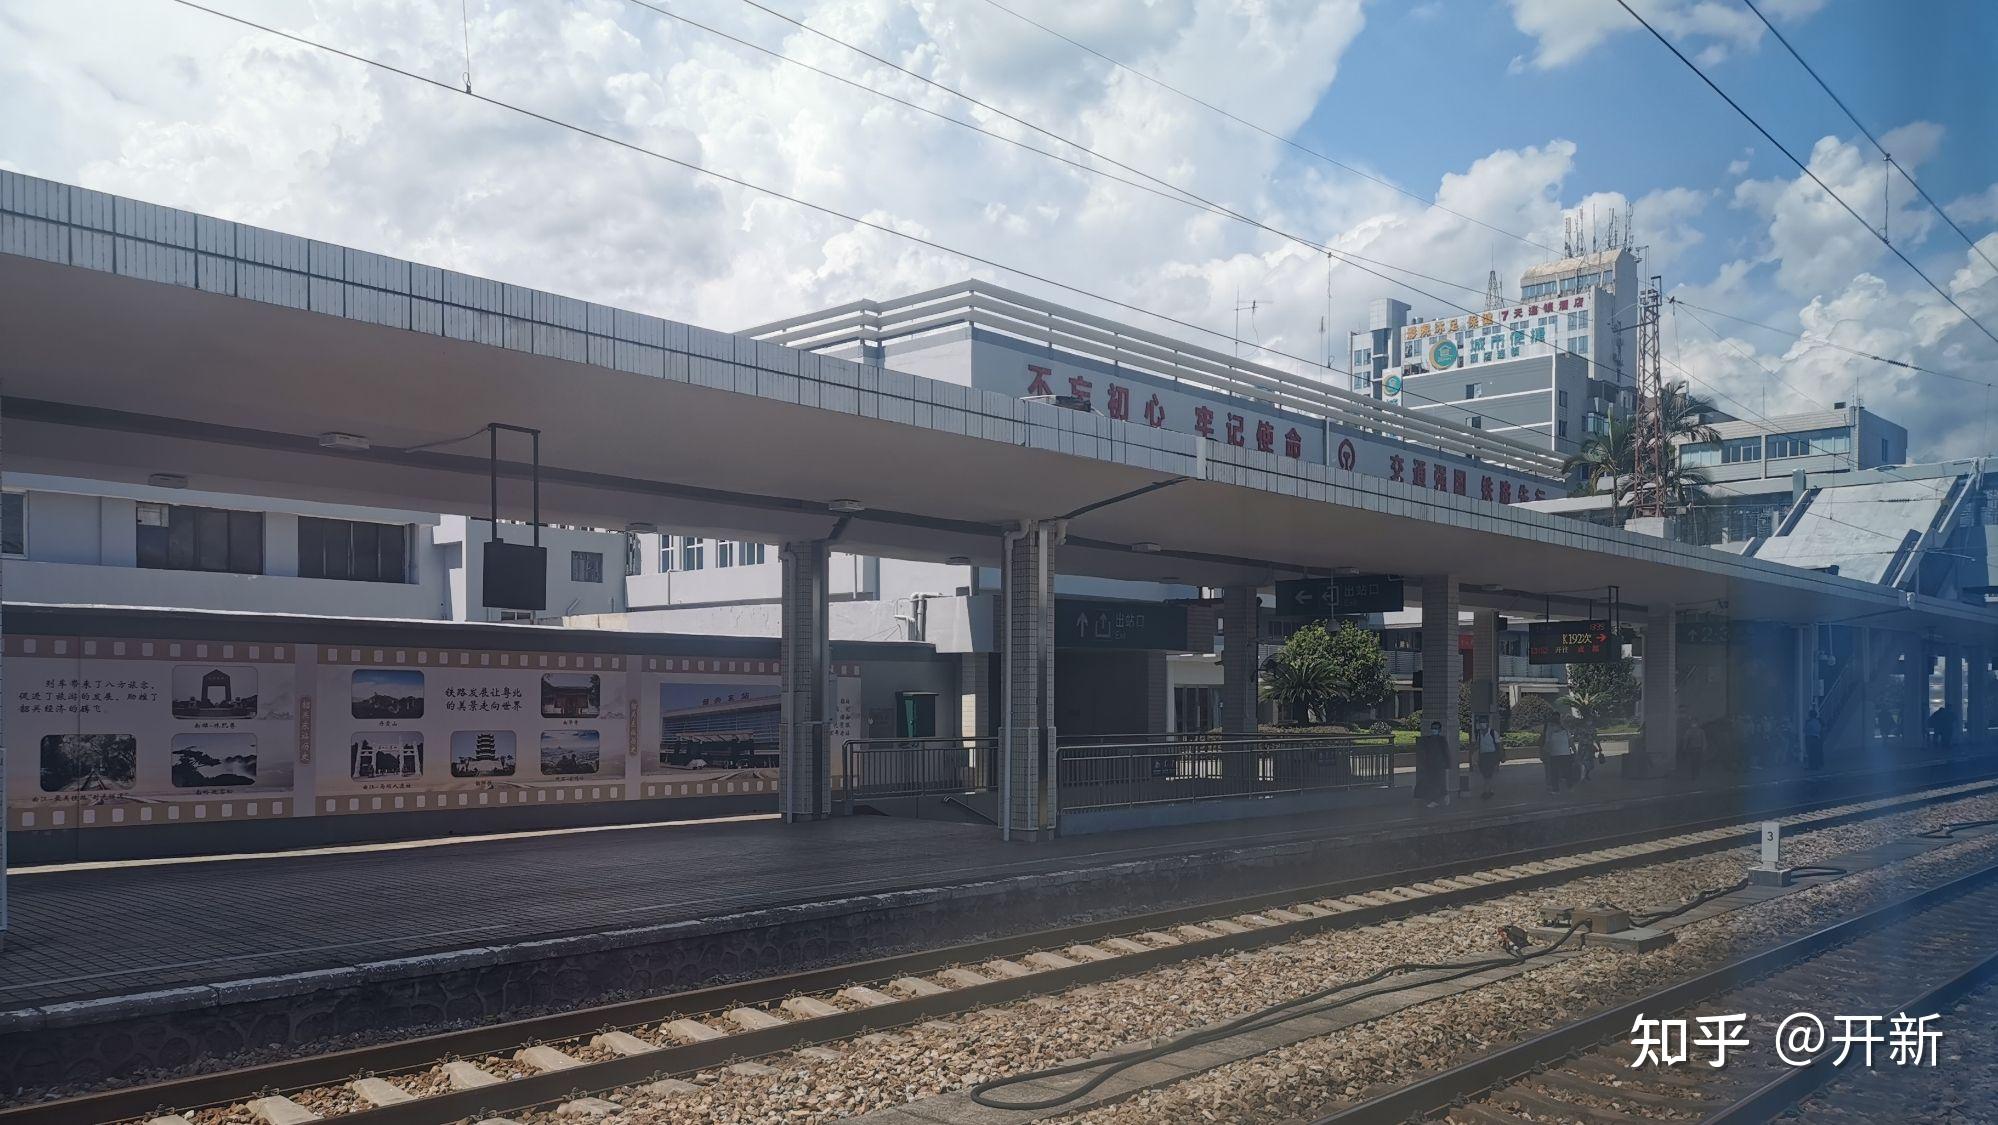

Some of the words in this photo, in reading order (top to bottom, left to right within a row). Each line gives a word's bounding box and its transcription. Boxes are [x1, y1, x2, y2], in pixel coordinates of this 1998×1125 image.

[1027, 364, 1165, 428] 不忘初心
[1194, 405, 1302, 459] 牢记使命
[1115, 613, 1145, 628] 出站口
[445, 687, 522, 699] 铁路发展让粤北
[446, 701, 522, 712] 的美景走向世界
[1767, 831, 1774, 841] 3
